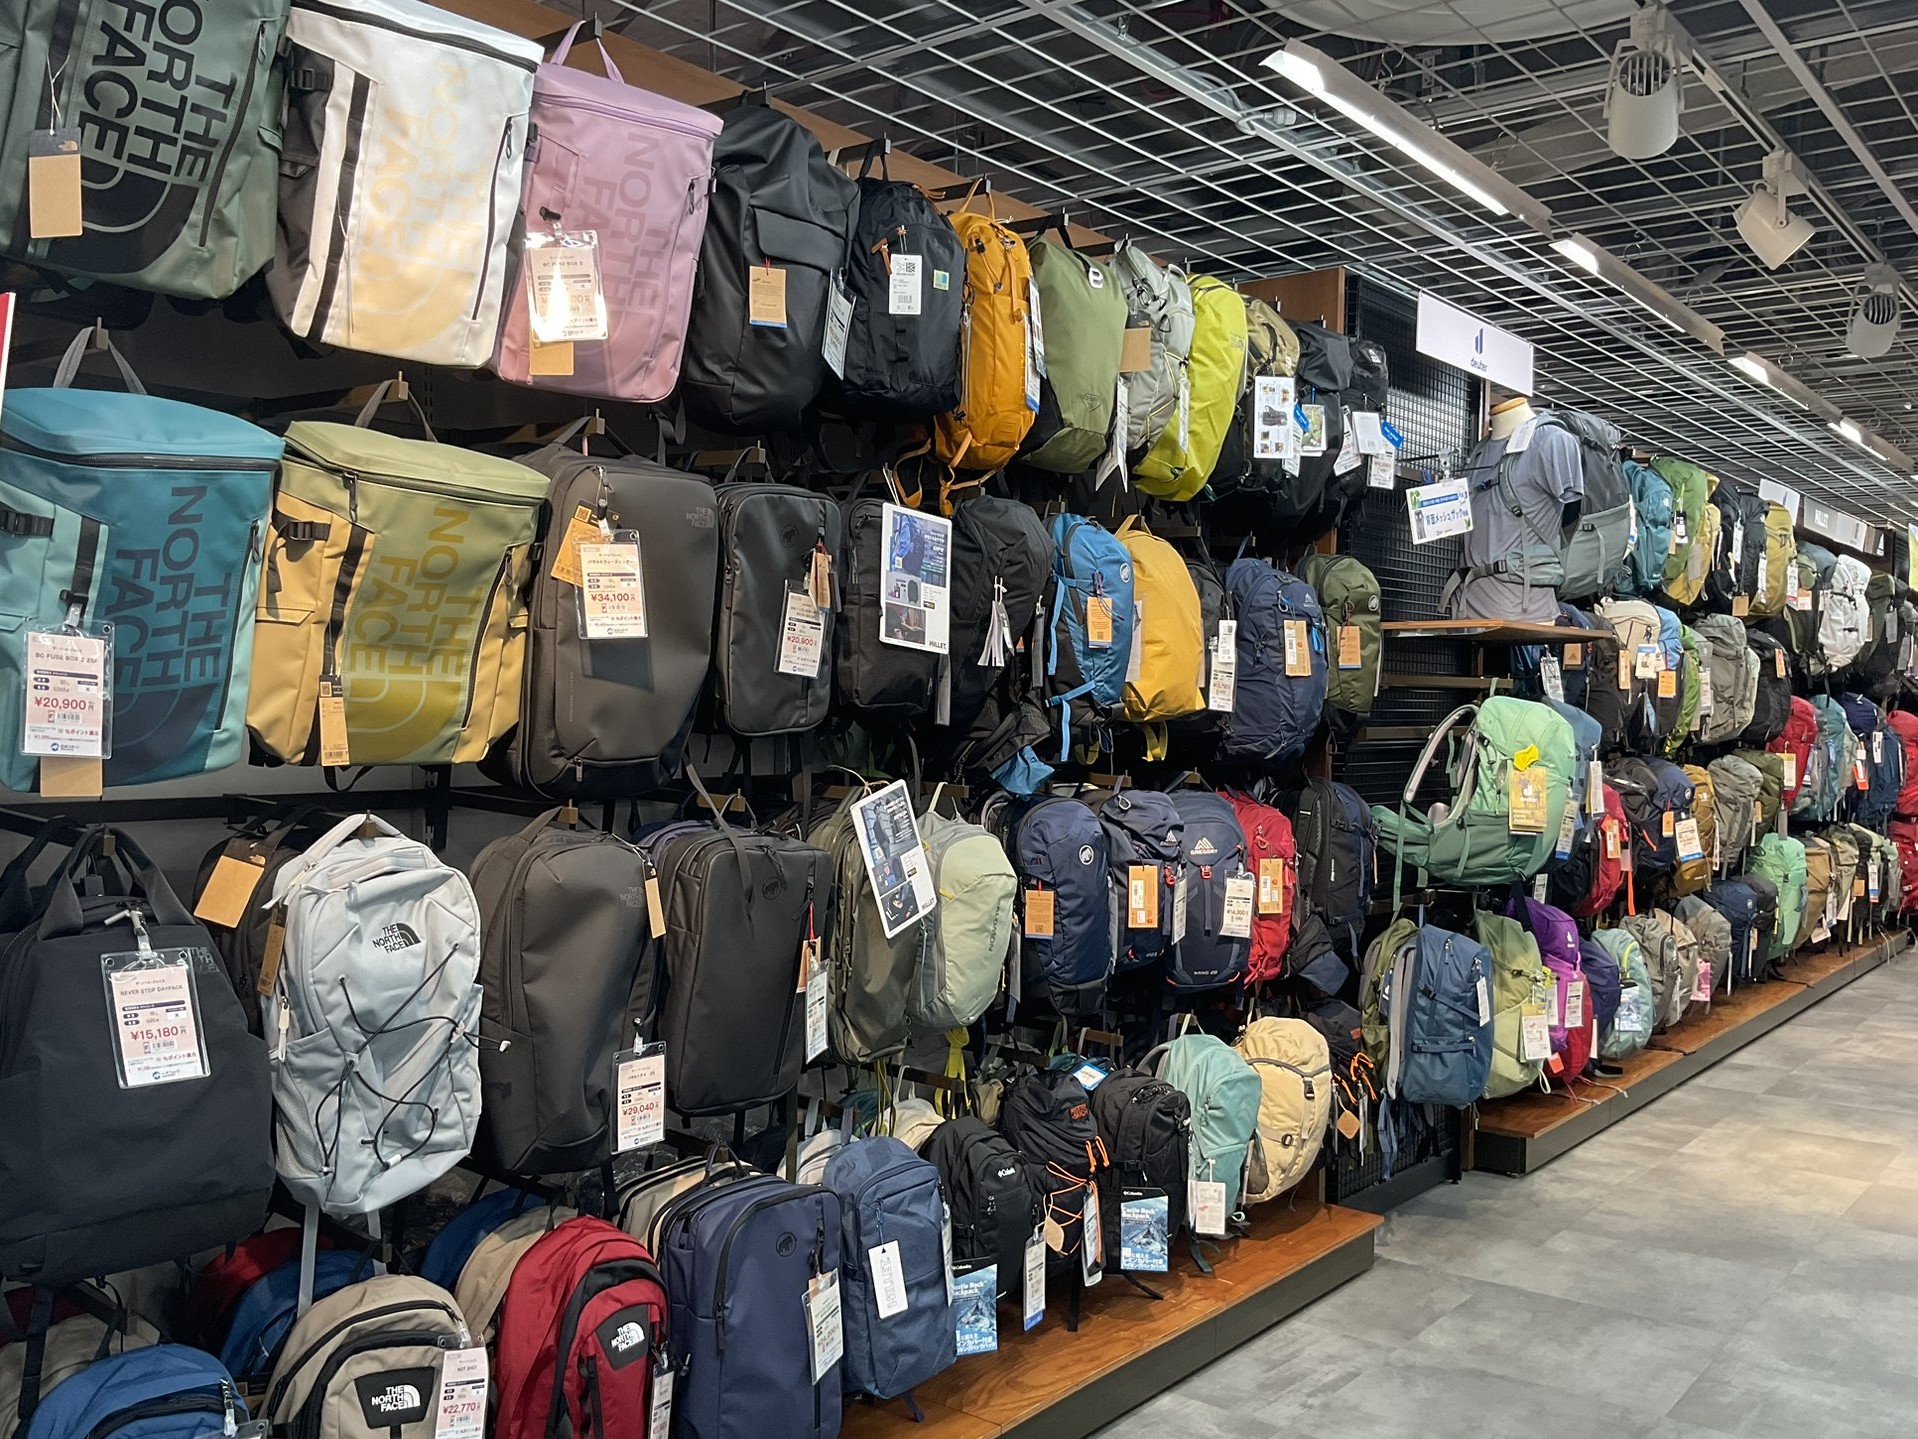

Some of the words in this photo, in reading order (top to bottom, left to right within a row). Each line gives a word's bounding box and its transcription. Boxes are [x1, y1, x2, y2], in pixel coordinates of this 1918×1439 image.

[77, 0, 155, 160] FACE
[127, 0, 203, 175] ORTH
[173, 72, 237, 182] THE
[604, 132, 660, 310] NORTH
[625, 226, 674, 318] THE
[1470, 357, 1488, 372] deuter
[142, 485, 208, 688] NORTH
[387, 507, 470, 675] NORTH
[591, 593, 630, 602] ¥34,100
[104, 548, 160, 691] FACE
[350, 554, 419, 674] FACE
[183, 573, 231, 681] THE
[427, 585, 482, 677] THE
[46, 653, 65, 661] FUSE
[34, 697, 87, 709] ¥20,900
[1190, 848, 1218, 856] GREGORY
[382, 923, 397, 936] THE
[372, 933, 402, 949] NORTH
[384, 941, 406, 954] FACE
[120, 988, 140, 996] NEVER
[141, 986, 156, 995] STOP
[157, 984, 183, 993] DAYPACK
[130, 1026, 179, 1041] ¥15,180
[622, 1102, 655, 1116] ¥29,040
[385, 1385, 404, 1393] THE
[371, 1393, 404, 1406] NORTH
[380, 1401, 404, 1413] FACE
[443, 1402, 476, 1415] ¥22,770
